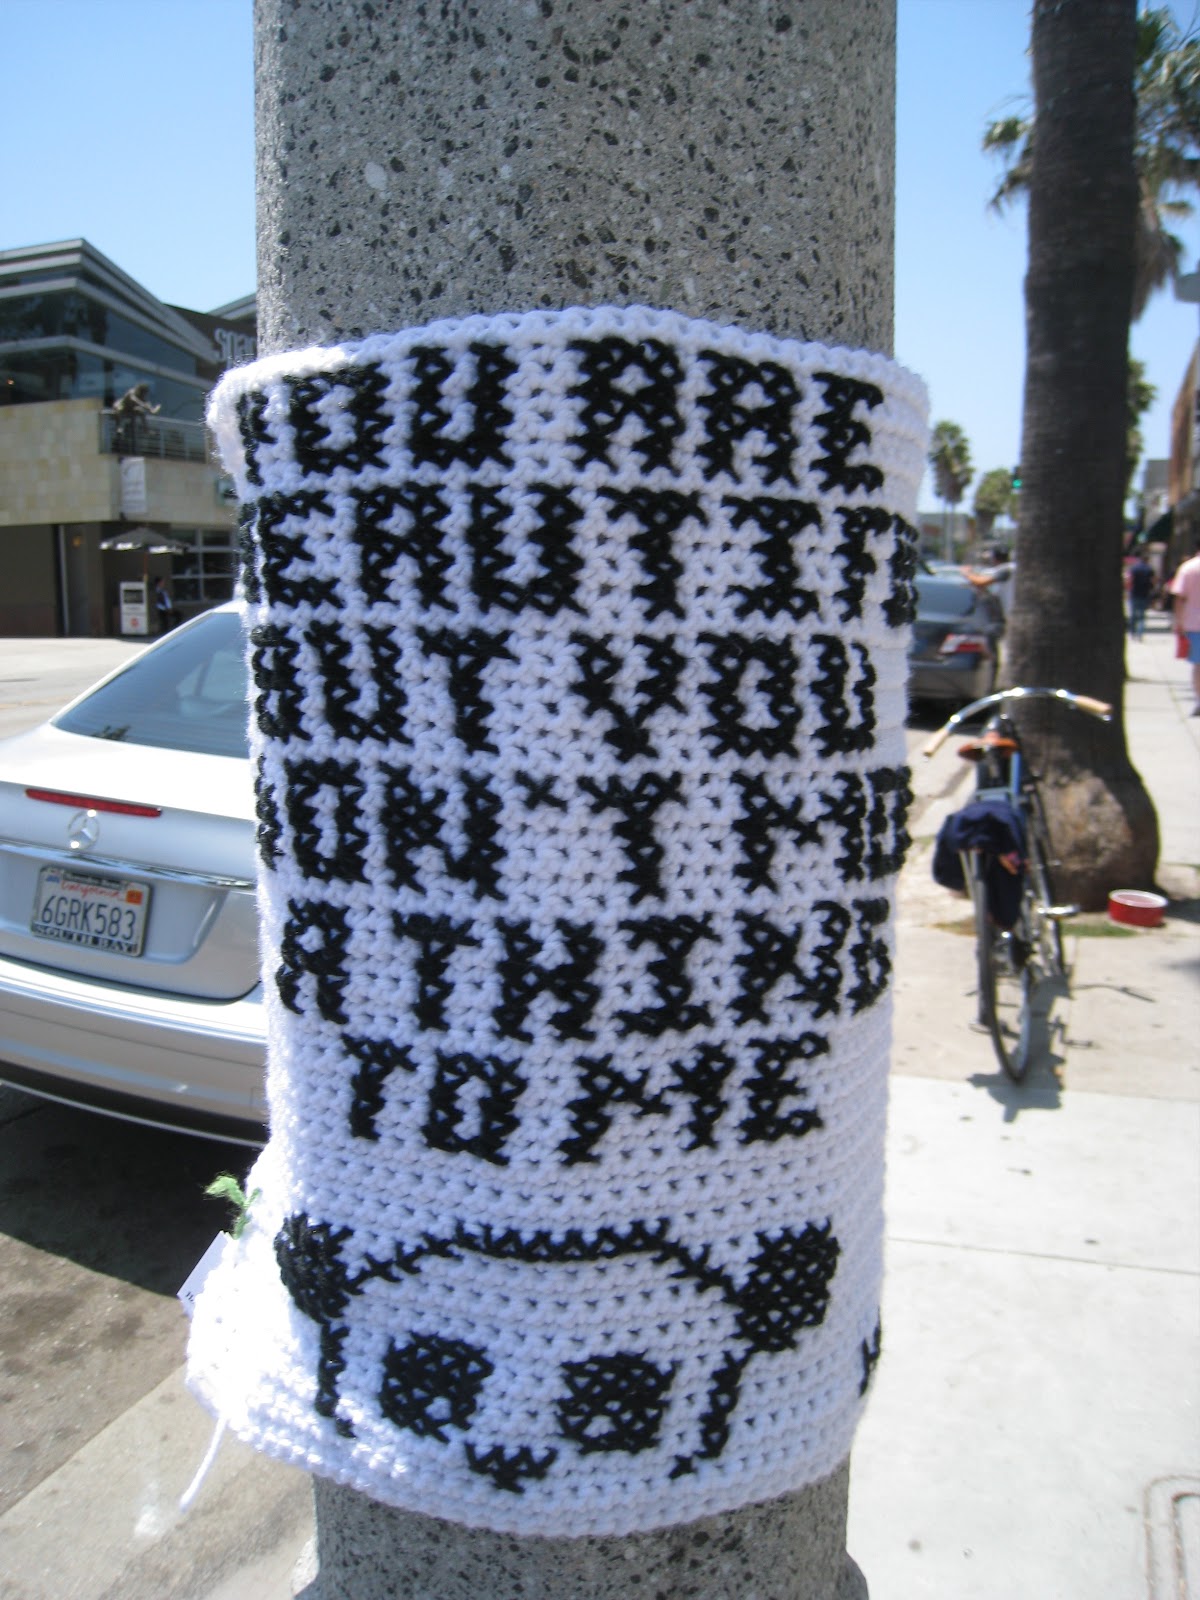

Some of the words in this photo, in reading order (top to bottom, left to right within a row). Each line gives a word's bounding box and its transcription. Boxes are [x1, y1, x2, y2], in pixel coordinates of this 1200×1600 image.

[236, 341, 514, 487] YOU
[568, 336, 884, 494] ARE
[251, 620, 517, 755] BUT
[570, 631, 876, 761] YOU
[41, 895, 136, 941] 6GRK583
[276, 897, 350, 1025] A
[391, 897, 891, 1043] THING
[342, 1033, 526, 1166] TO
[557, 1031, 829, 1169] ME
